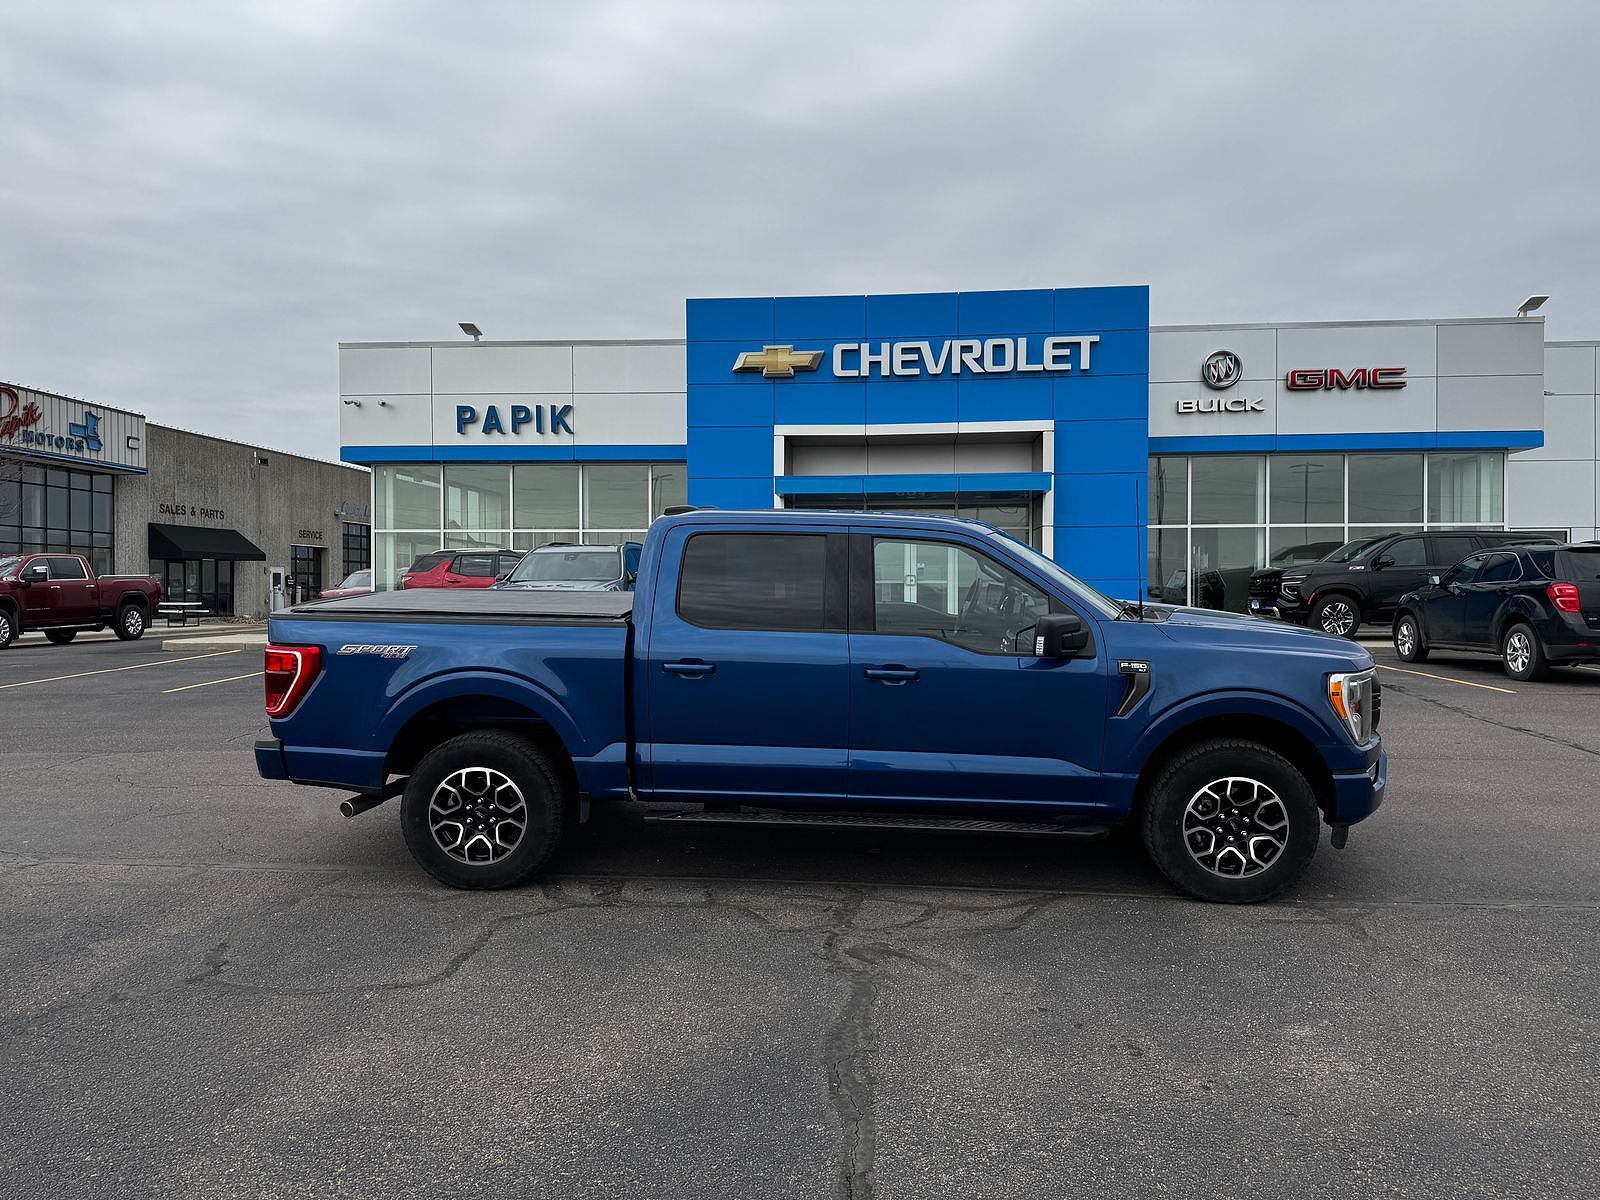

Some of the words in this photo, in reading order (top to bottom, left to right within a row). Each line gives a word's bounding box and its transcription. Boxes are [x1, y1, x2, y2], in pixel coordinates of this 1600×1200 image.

[833, 335, 1100, 377] CHEVROLET
[1287, 367, 1407, 390] GMC
[1177, 398, 1265, 414] BUICK
[456, 404, 575, 435] PAPIK
[22, 429, 84, 452] MOTORS
[159, 503, 187, 516] SALES
[190, 506, 196, 517] &
[200, 508, 225, 520] PARTS
[298, 529, 323, 540] SERVICE
[336, 644, 418, 656] SPORT
